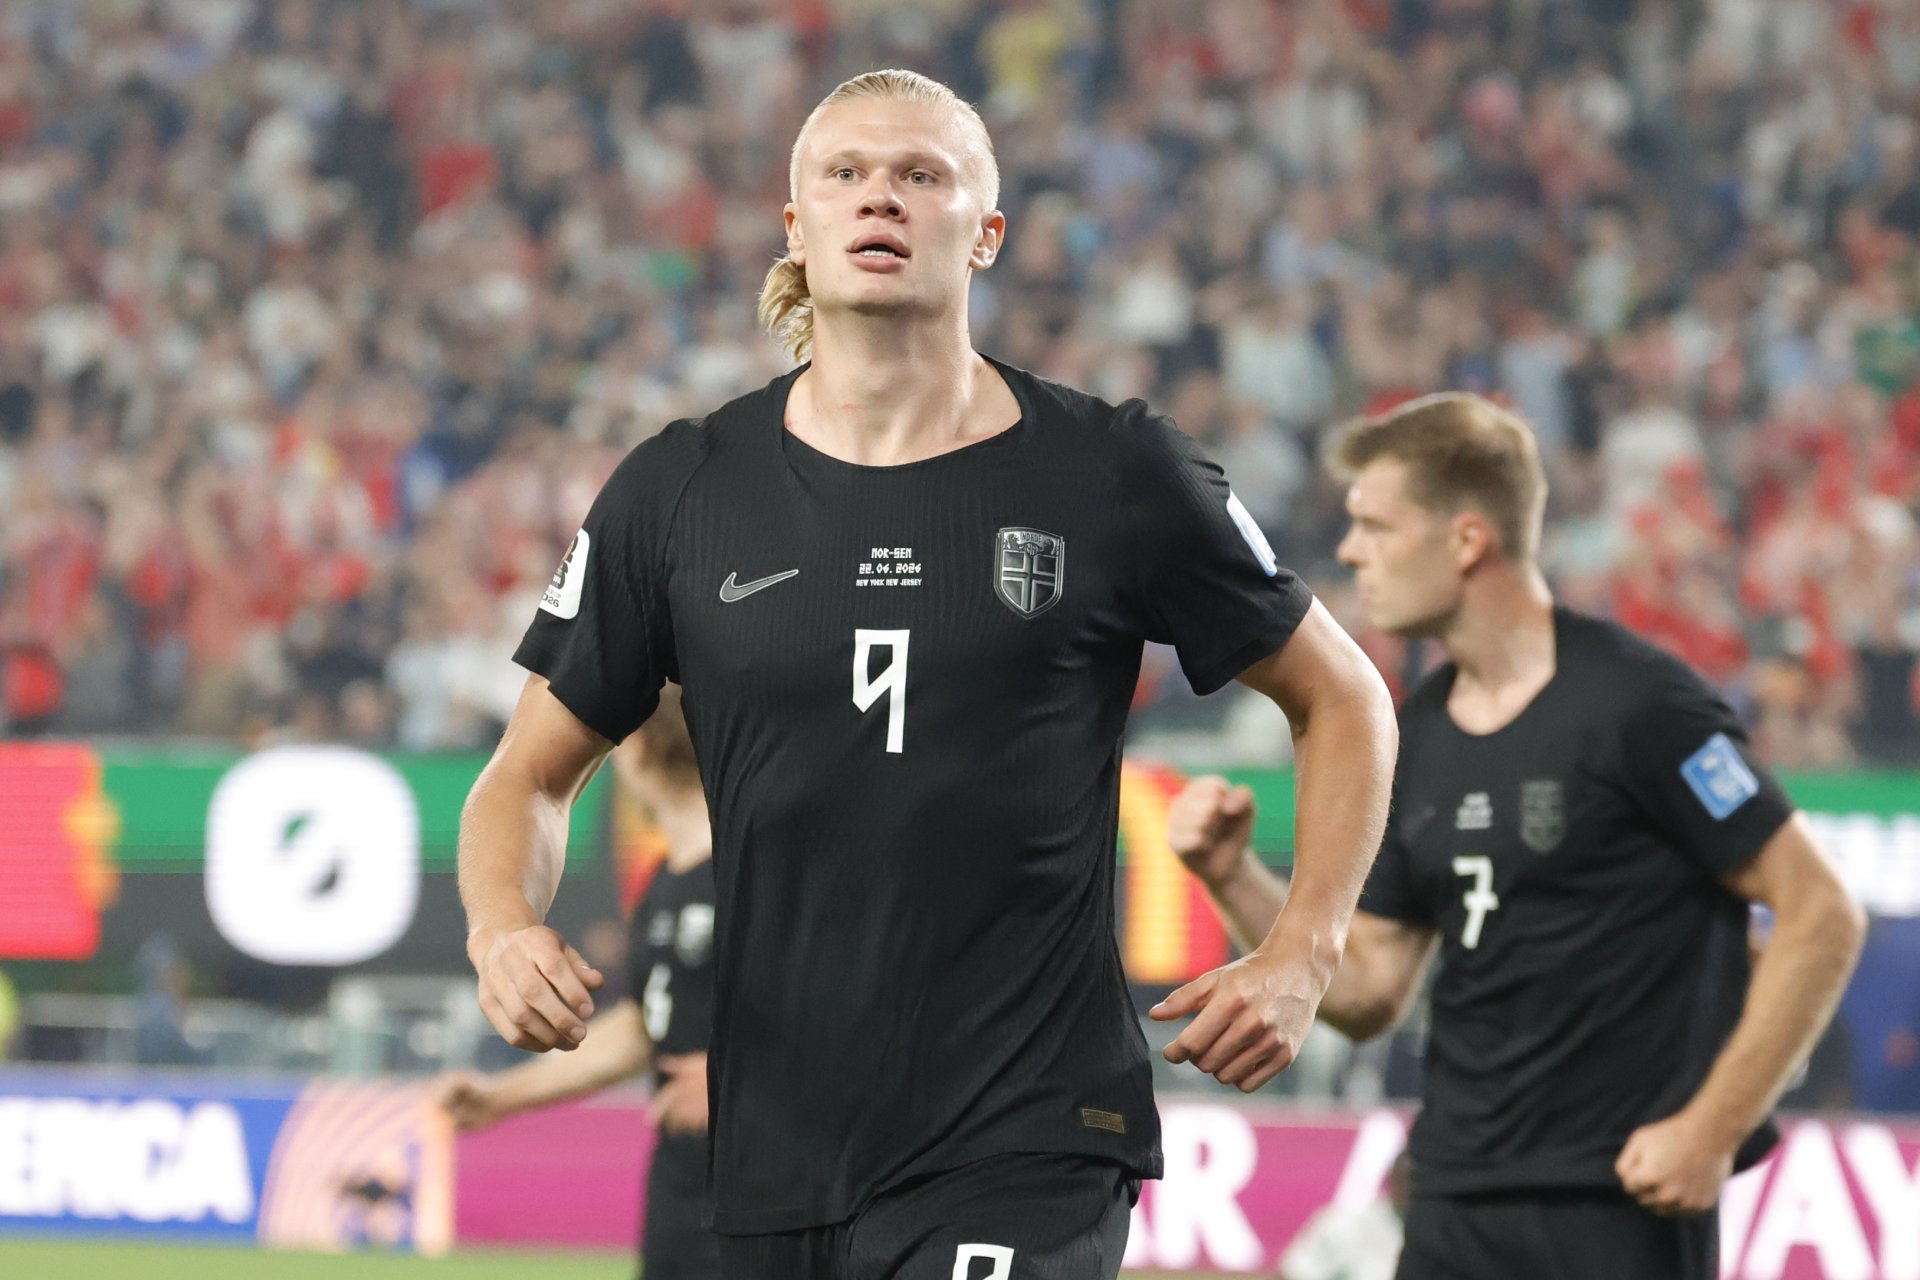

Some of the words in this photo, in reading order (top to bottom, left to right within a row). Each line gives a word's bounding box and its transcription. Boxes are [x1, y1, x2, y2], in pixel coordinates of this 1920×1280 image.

[871, 547, 912, 559] NOR-SEN
[855, 578, 869, 587] NEW
[870, 578, 885, 587] YORK
[886, 578, 899, 587] NEW
[900, 578, 922, 587] JERSEY
[852, 628, 910, 754] 9
[1452, 855, 1499, 950] 7
